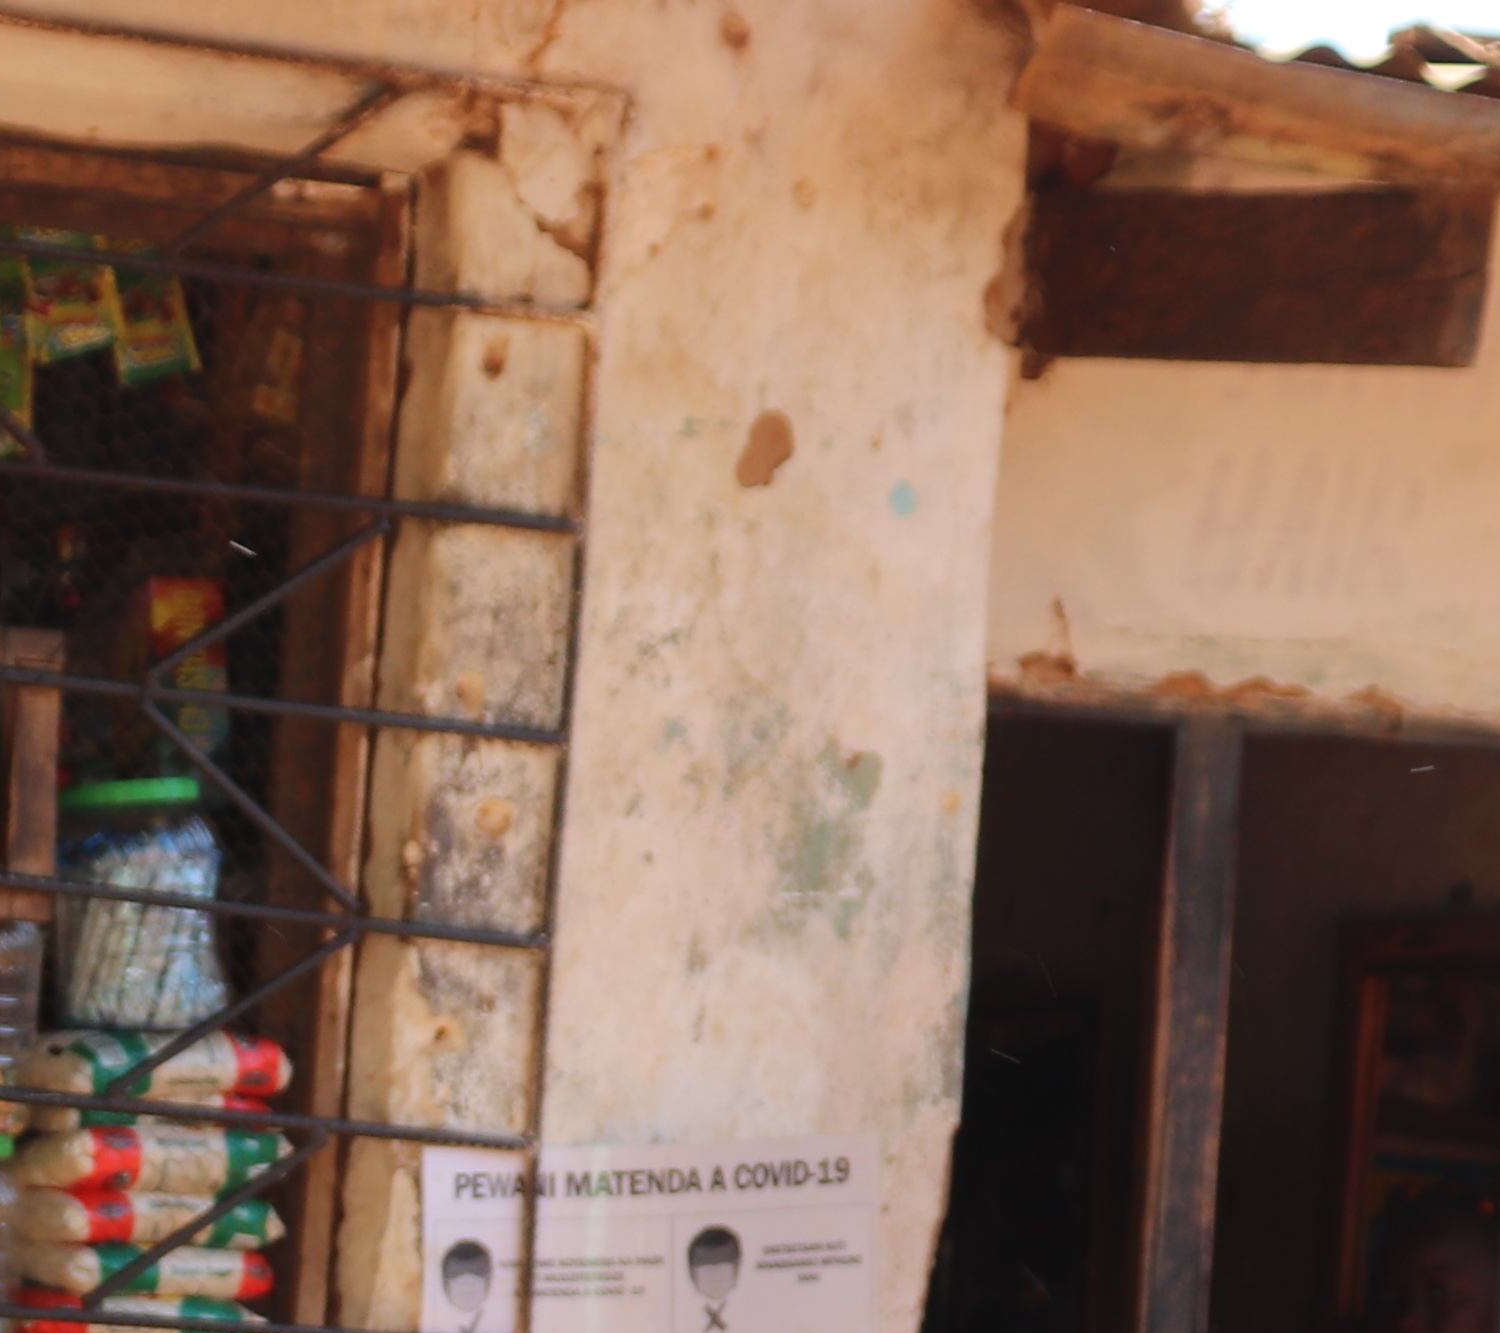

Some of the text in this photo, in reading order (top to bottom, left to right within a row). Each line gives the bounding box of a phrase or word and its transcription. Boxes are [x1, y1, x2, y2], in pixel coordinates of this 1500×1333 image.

[566, 1167, 702, 1198] MATENDA
[709, 1165, 727, 1191] A
[733, 1156, 851, 1189] COVID-19
